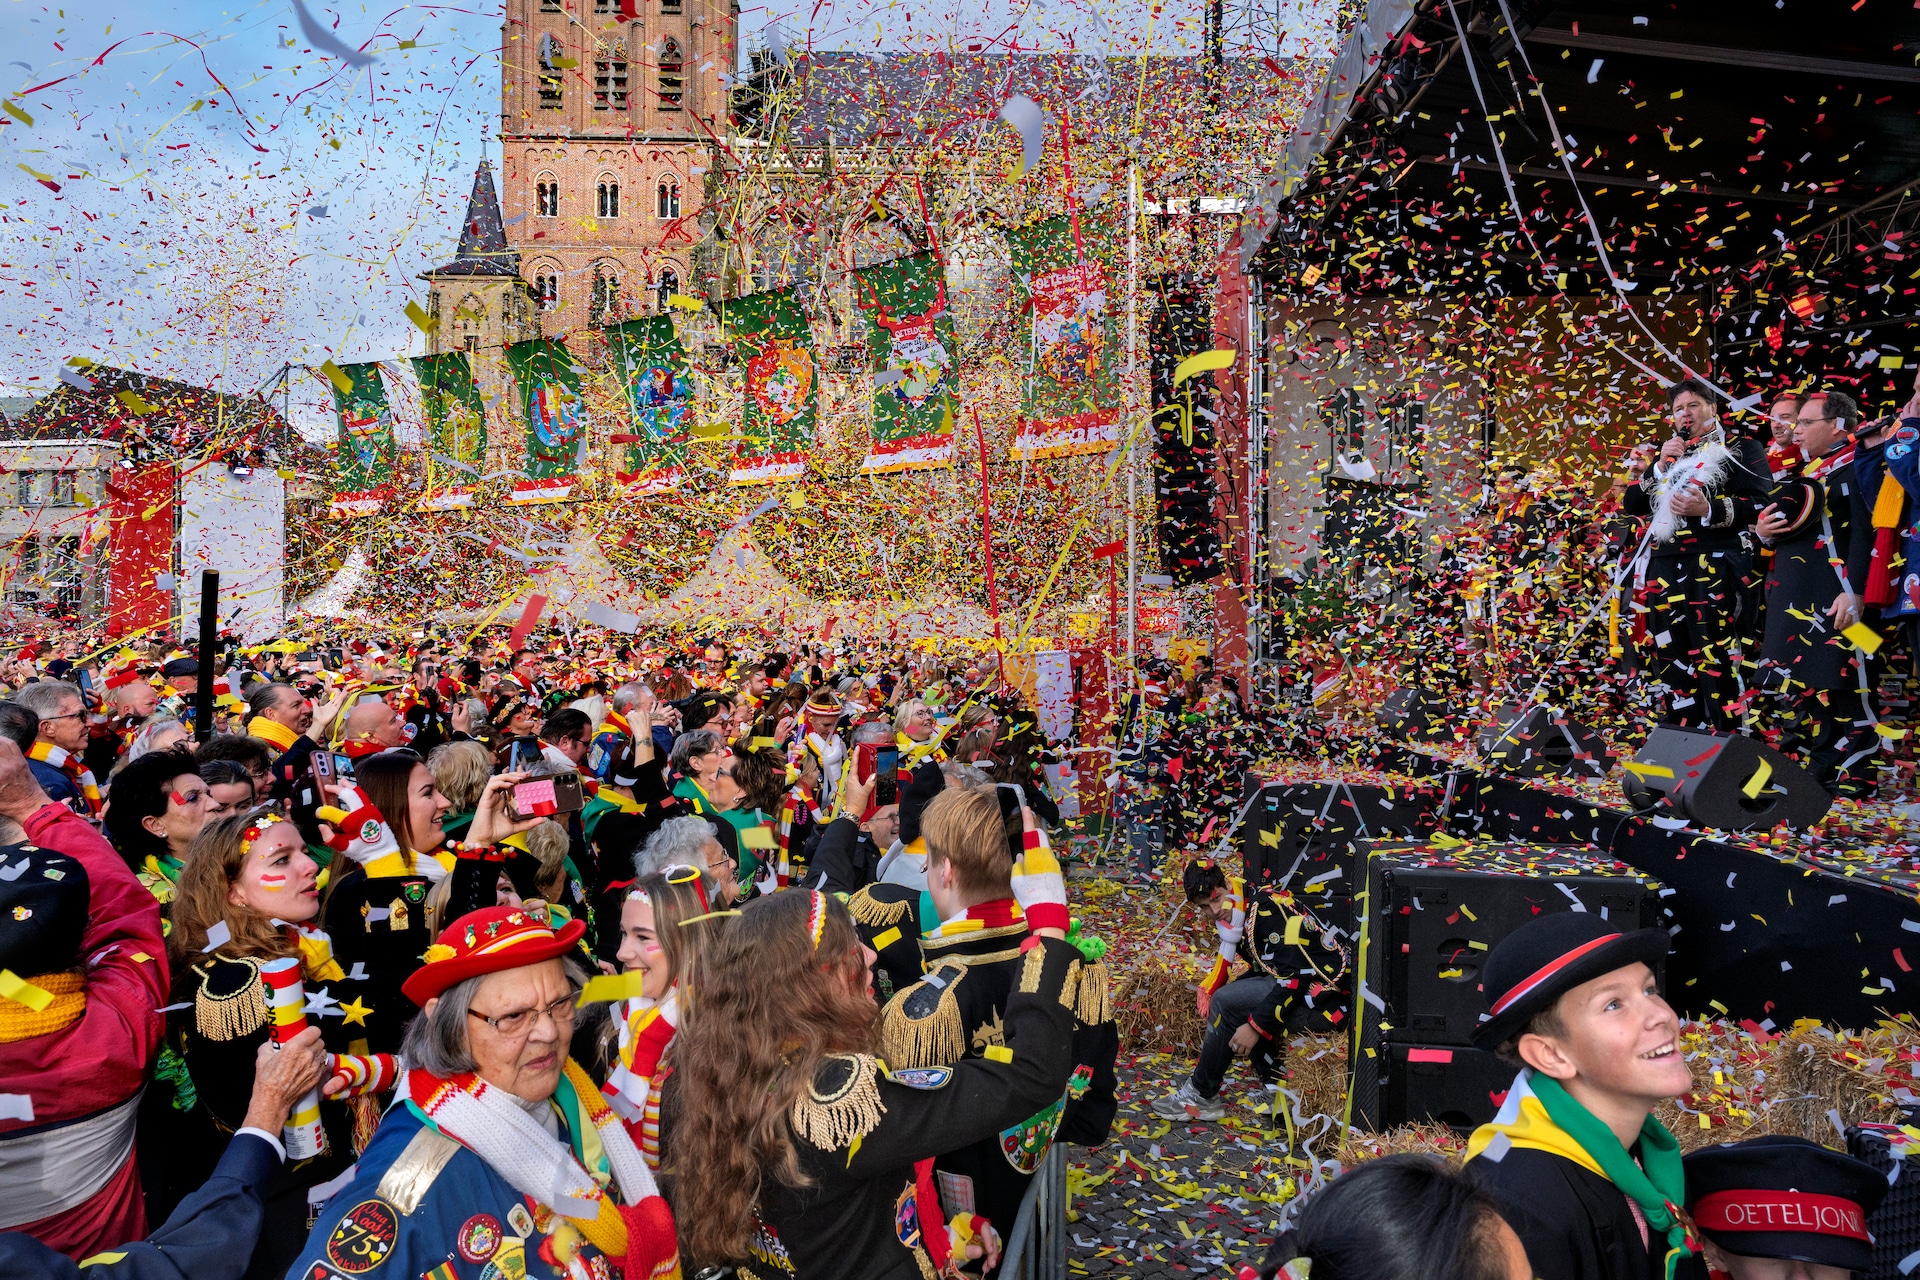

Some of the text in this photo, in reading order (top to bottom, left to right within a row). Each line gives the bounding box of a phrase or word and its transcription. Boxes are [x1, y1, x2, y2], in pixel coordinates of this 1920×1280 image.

[350, 1204, 395, 1242] Koosje
[364, 1202, 388, 1225] Oma
[330, 1239, 370, 1271] Kwakbol
[337, 1223, 382, 1256] 75
